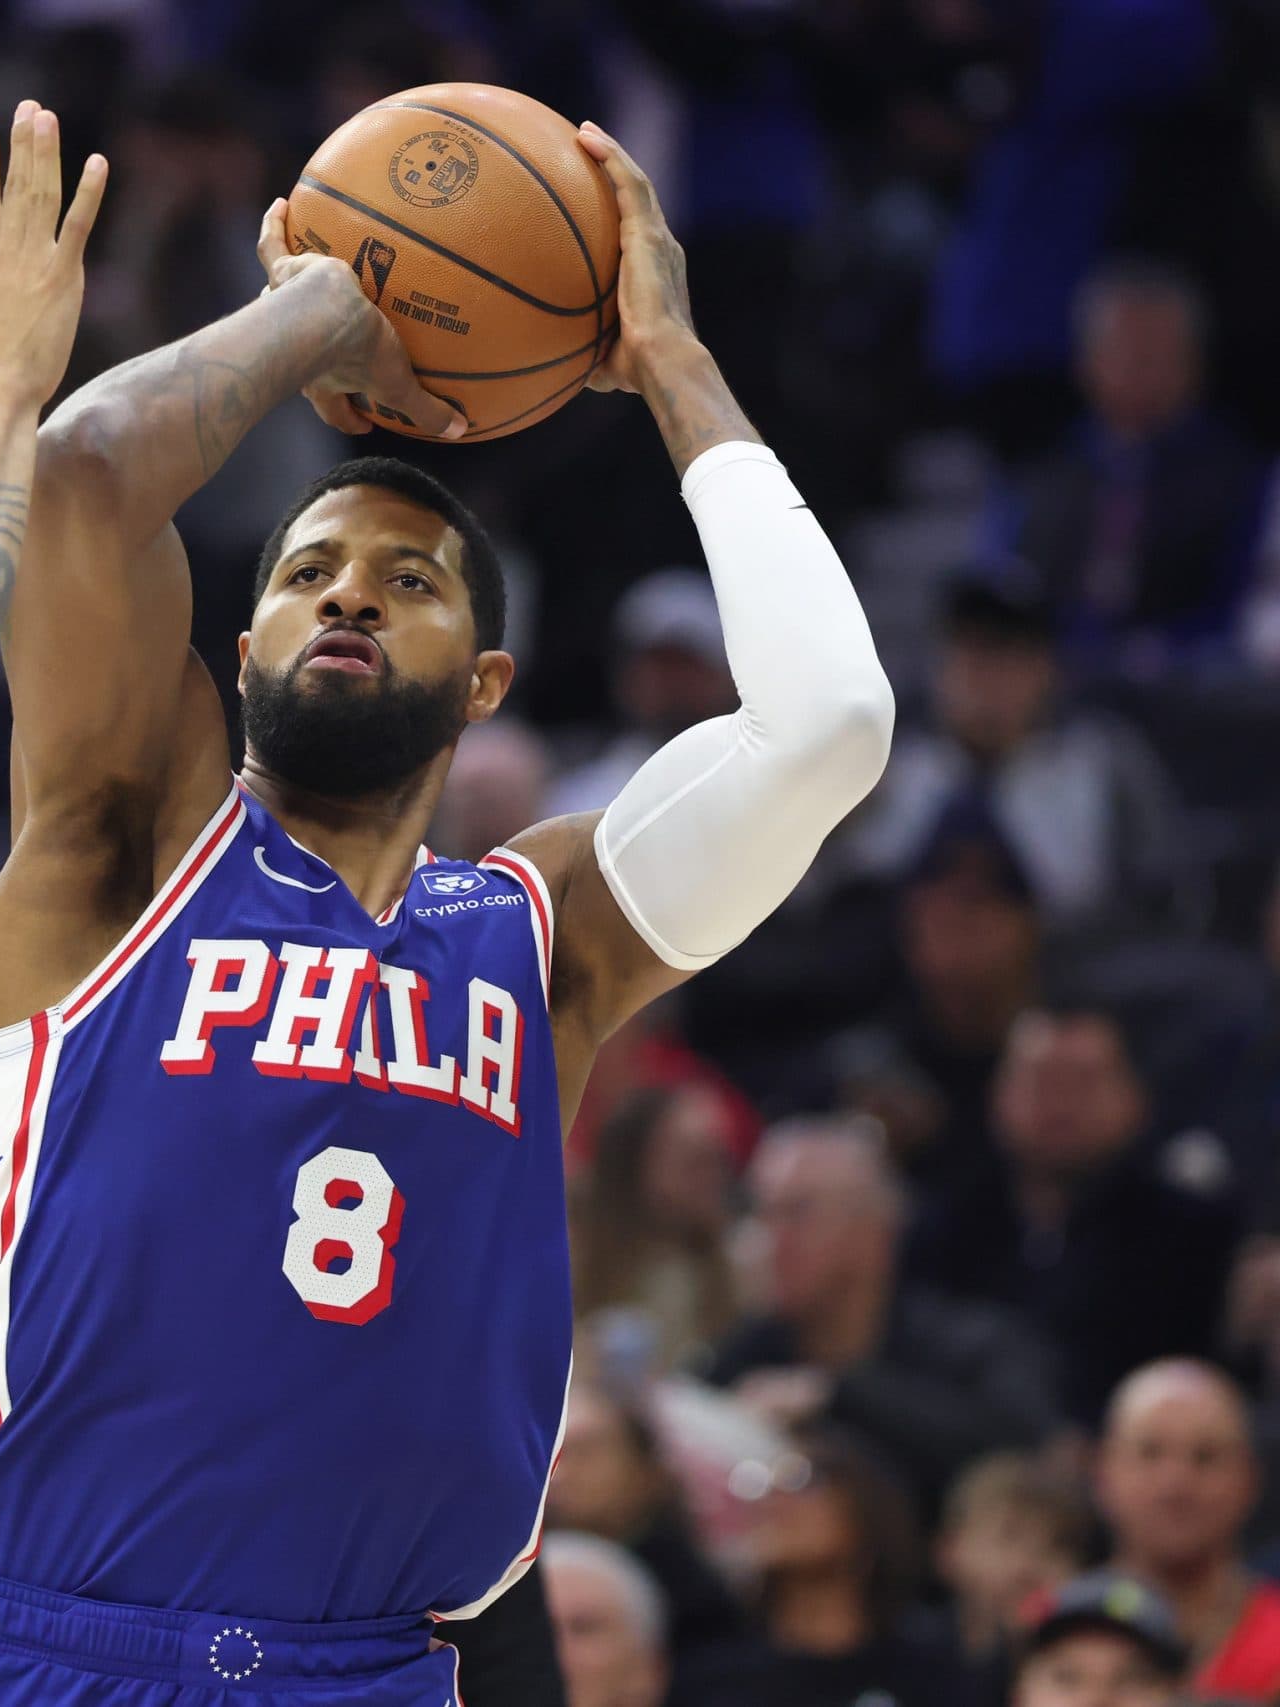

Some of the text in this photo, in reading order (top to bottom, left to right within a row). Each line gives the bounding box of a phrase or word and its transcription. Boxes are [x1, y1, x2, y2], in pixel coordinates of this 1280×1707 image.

[391, 296, 471, 336] OFFICIAL GAME BALL
[414, 892, 525, 919] crypto.com
[160, 938, 525, 1138] PHILA
[282, 1145, 407, 1327] 8
